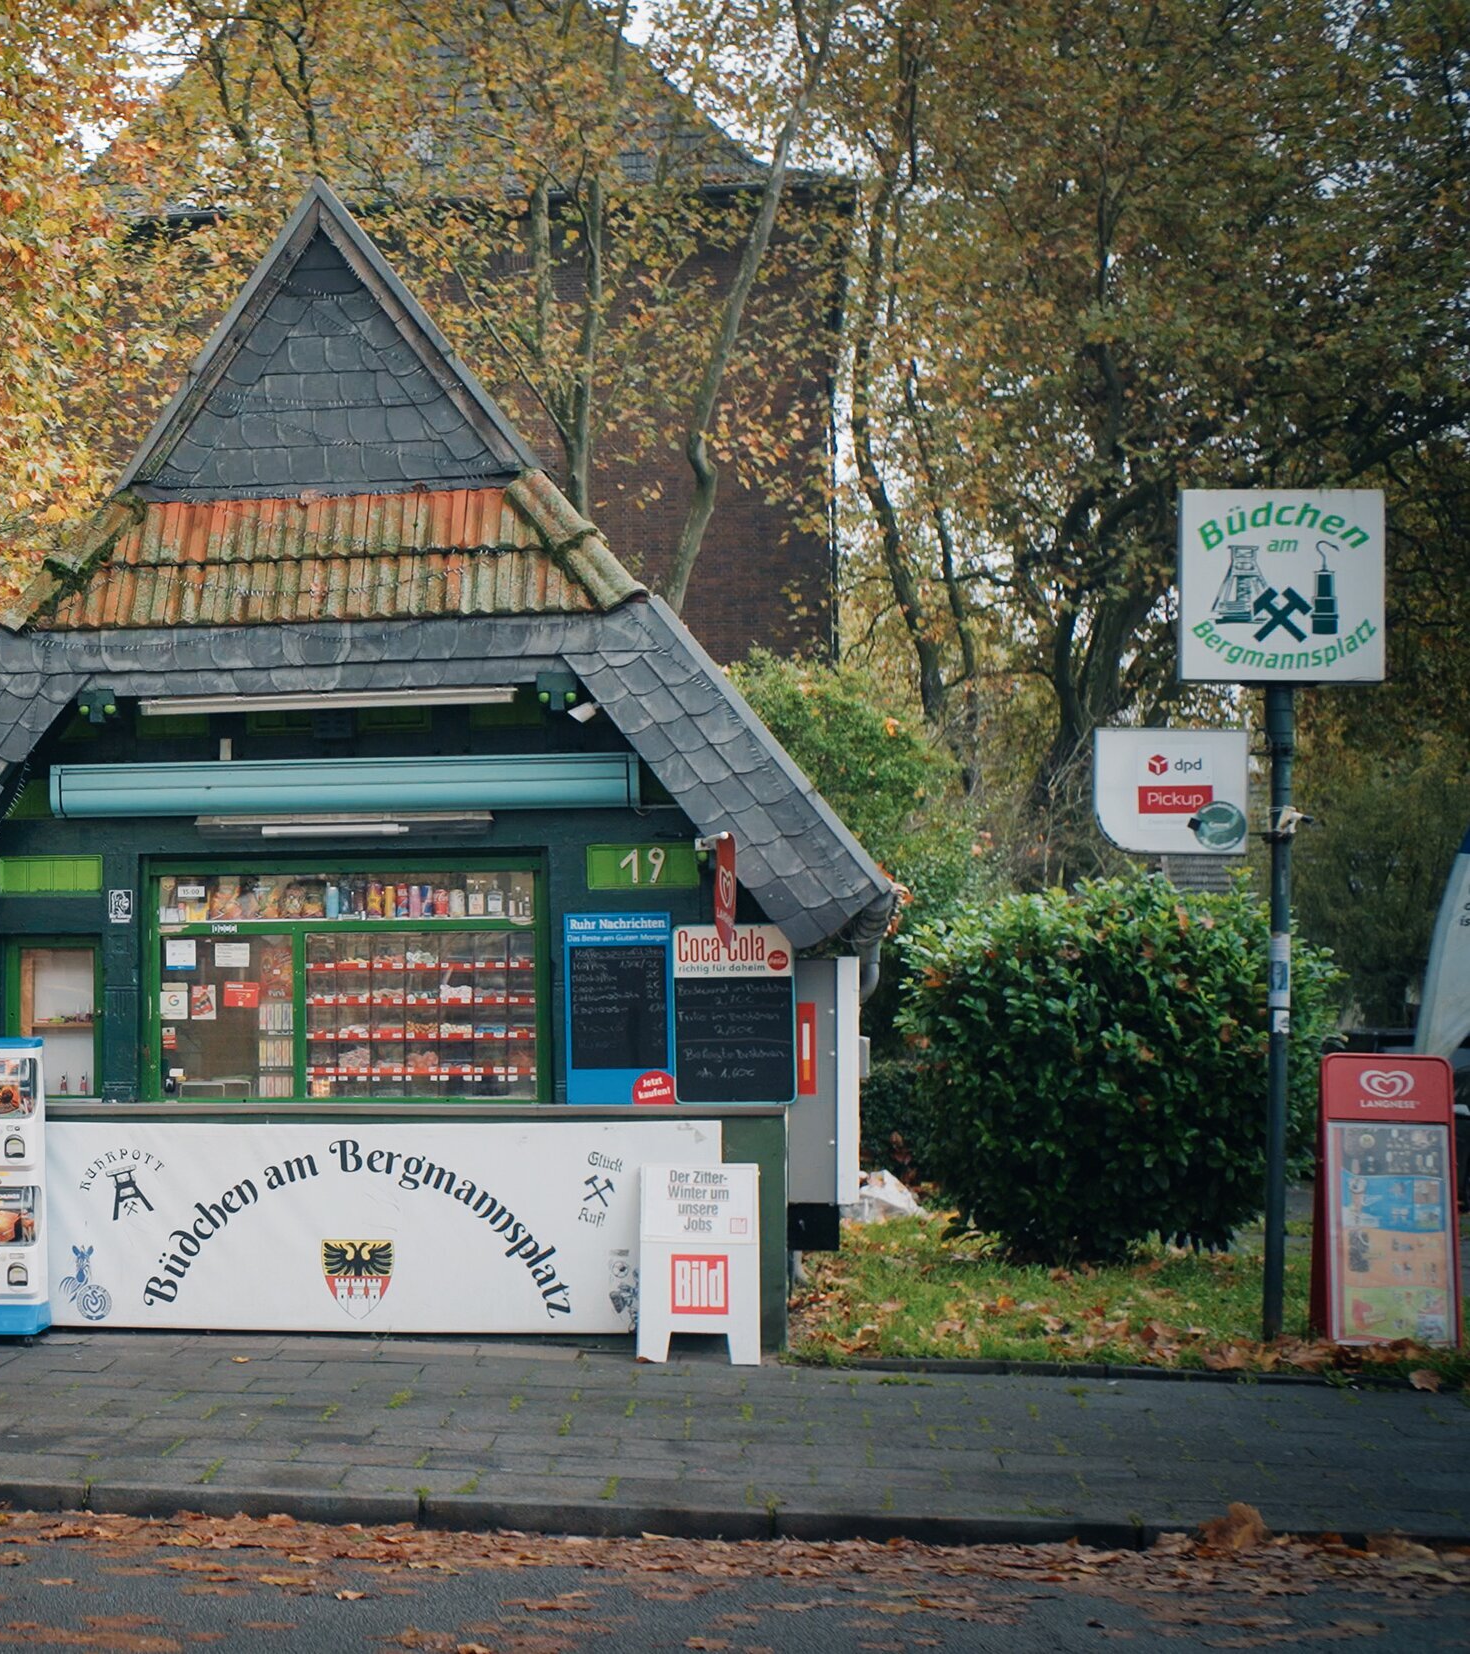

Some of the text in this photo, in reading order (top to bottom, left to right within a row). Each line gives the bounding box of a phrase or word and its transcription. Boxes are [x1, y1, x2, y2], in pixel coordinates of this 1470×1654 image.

[1197, 502, 1371, 551] Büdchen
[1267, 539, 1298, 553] am
[1192, 618, 1377, 670] Bergmannsplatz
[1174, 757, 1203, 773] dpd
[1147, 791, 1204, 808] Pickup
[620, 847, 666, 884] 19
[570, 917, 666, 930] Ruhr Nachrichten
[678, 963, 765, 974] richtig für daheim
[643, 1076, 663, 1088] Jetzt
[637, 1086, 671, 1100] kaufen!
[1360, 1099, 1416, 1109] LANGNESE
[587, 1151, 623, 1173] Glück
[670, 1169, 728, 1185] Der Zitter-
[668, 1185, 729, 1201] Winter um
[578, 1206, 606, 1229] Auf!
[678, 1203, 719, 1217] unsere
[143, 1139, 572, 1319] Büdchen am Bergmannsplatz
[683, 1217, 713, 1232] Jobs
[675, 1260, 725, 1308] Bild
